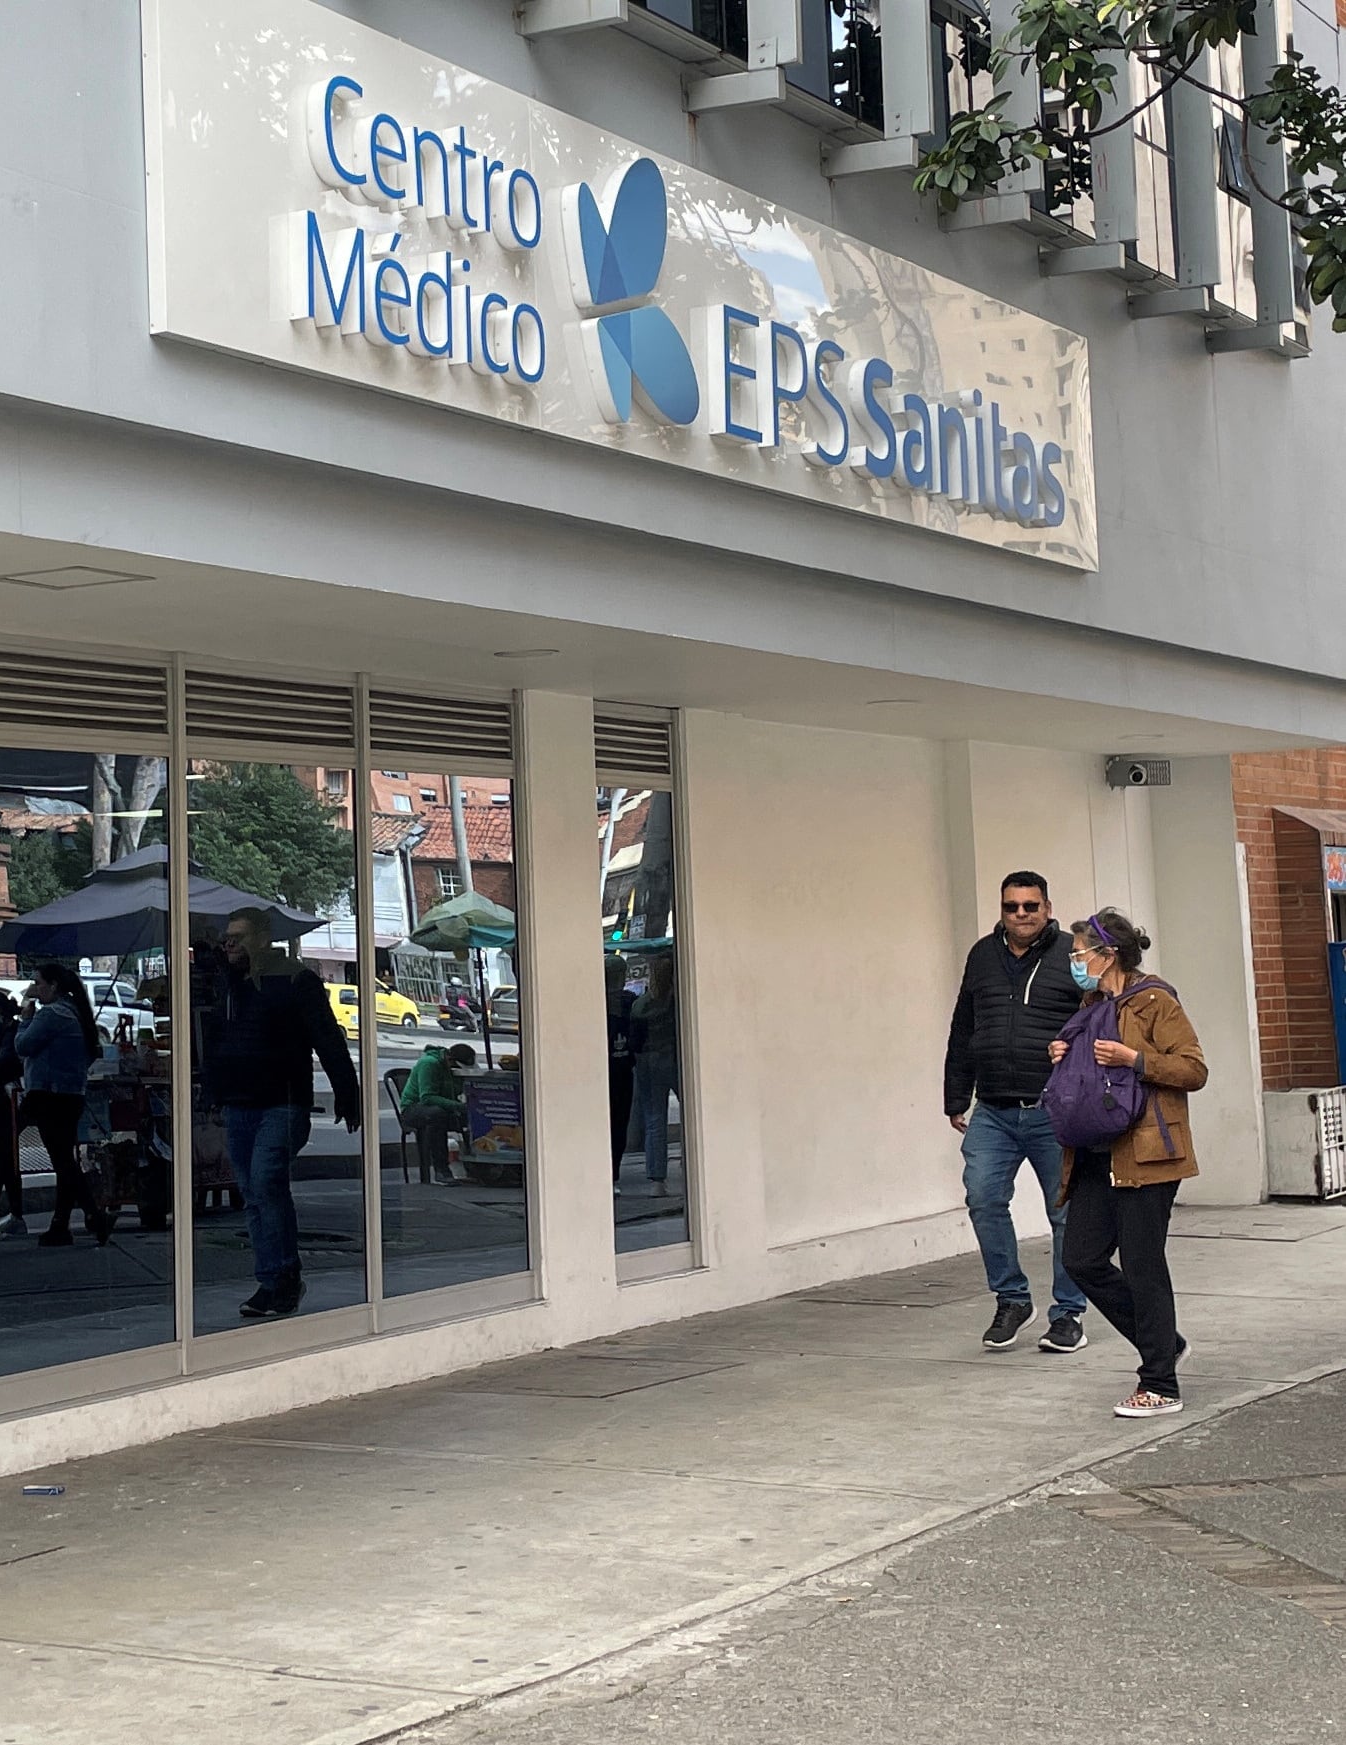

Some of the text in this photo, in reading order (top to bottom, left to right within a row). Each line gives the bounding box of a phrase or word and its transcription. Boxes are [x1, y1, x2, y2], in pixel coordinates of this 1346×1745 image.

[324, 74, 543, 250] Centro
[306, 209, 546, 384] Médico
[722, 304, 1065, 528] EPS Sanitas
